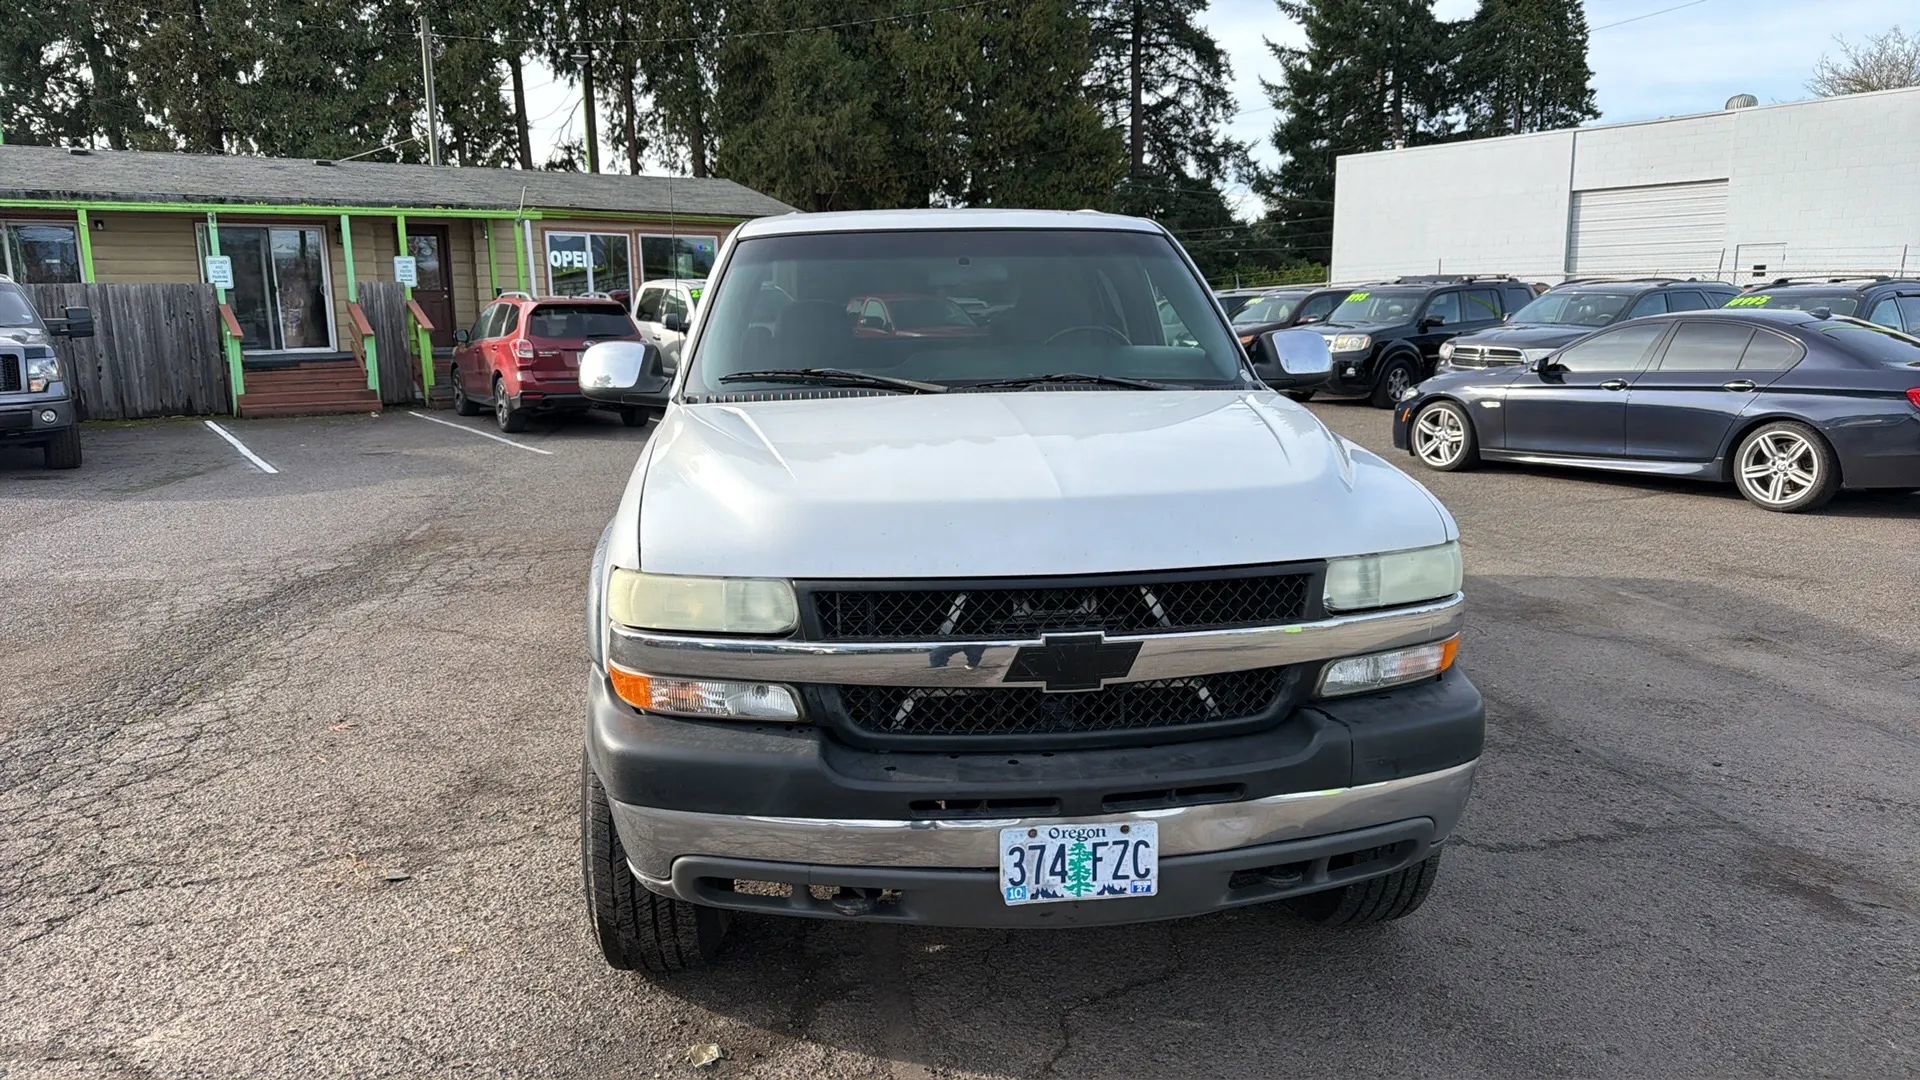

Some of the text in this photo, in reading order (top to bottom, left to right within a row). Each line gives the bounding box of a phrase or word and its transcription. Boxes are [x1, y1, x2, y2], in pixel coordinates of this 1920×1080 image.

[1048, 827, 1106, 842] Oregon
[1008, 840, 1151, 886] 374 FZC
[1009, 888, 1023, 899] 10
